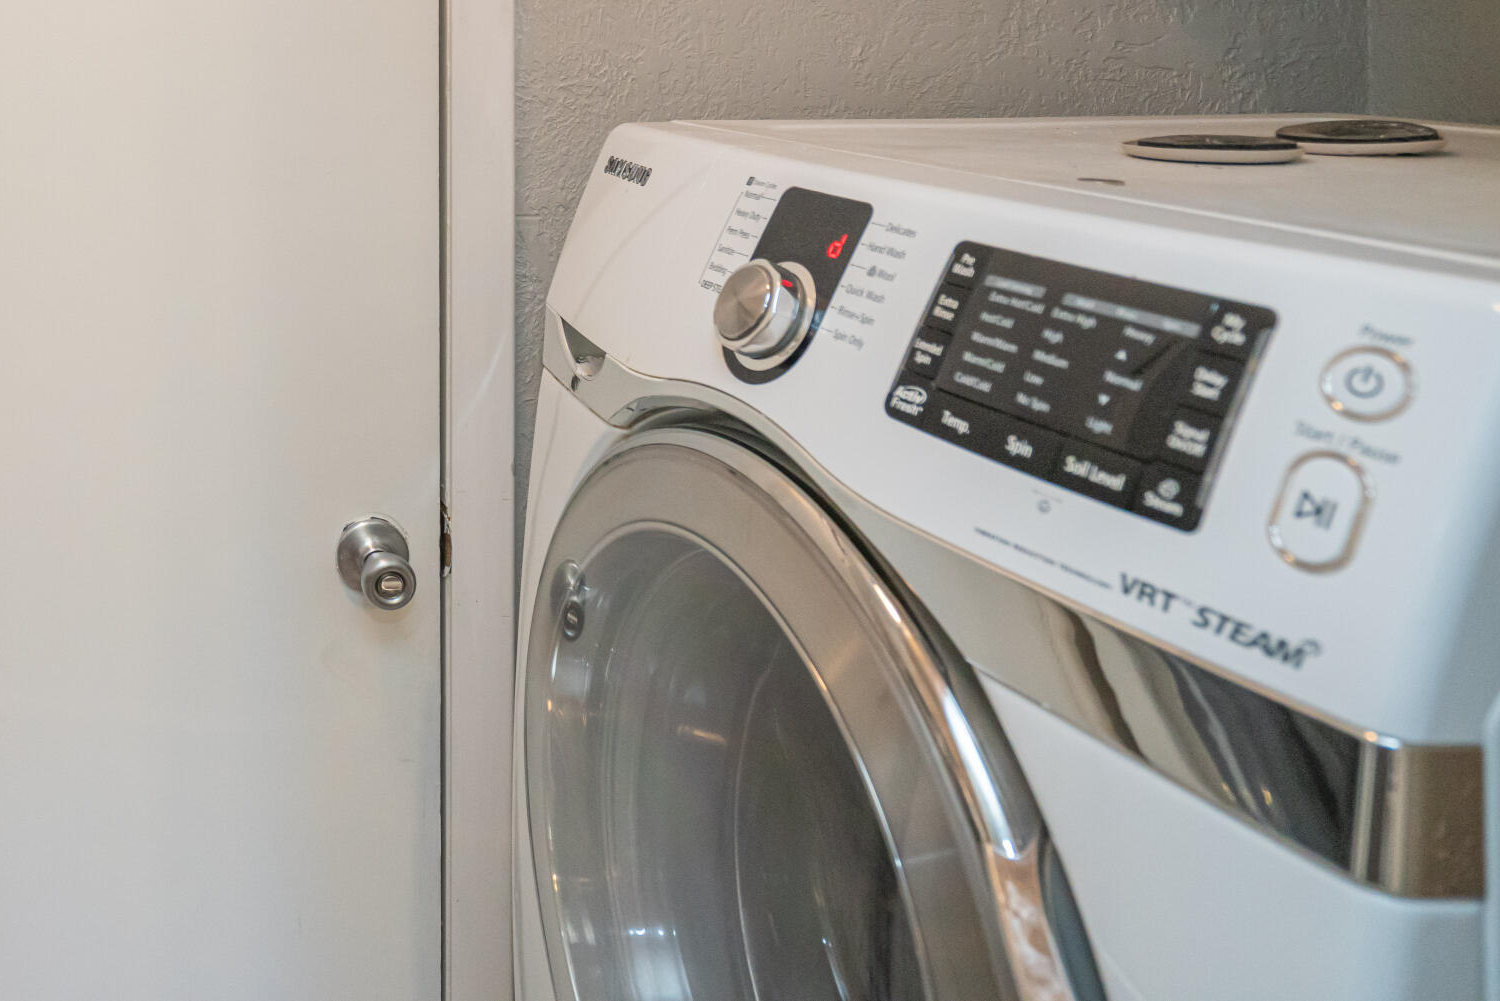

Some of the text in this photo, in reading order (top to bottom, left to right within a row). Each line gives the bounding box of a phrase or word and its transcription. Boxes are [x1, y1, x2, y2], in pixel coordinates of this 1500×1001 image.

[604, 155, 652, 187] SAMSUNG
[937, 294, 960, 309] Extra
[1004, 434, 1034, 459] Spin
[1063, 454, 1127, 491] Soil Level
[1190, 605, 1308, 669] STEAM
